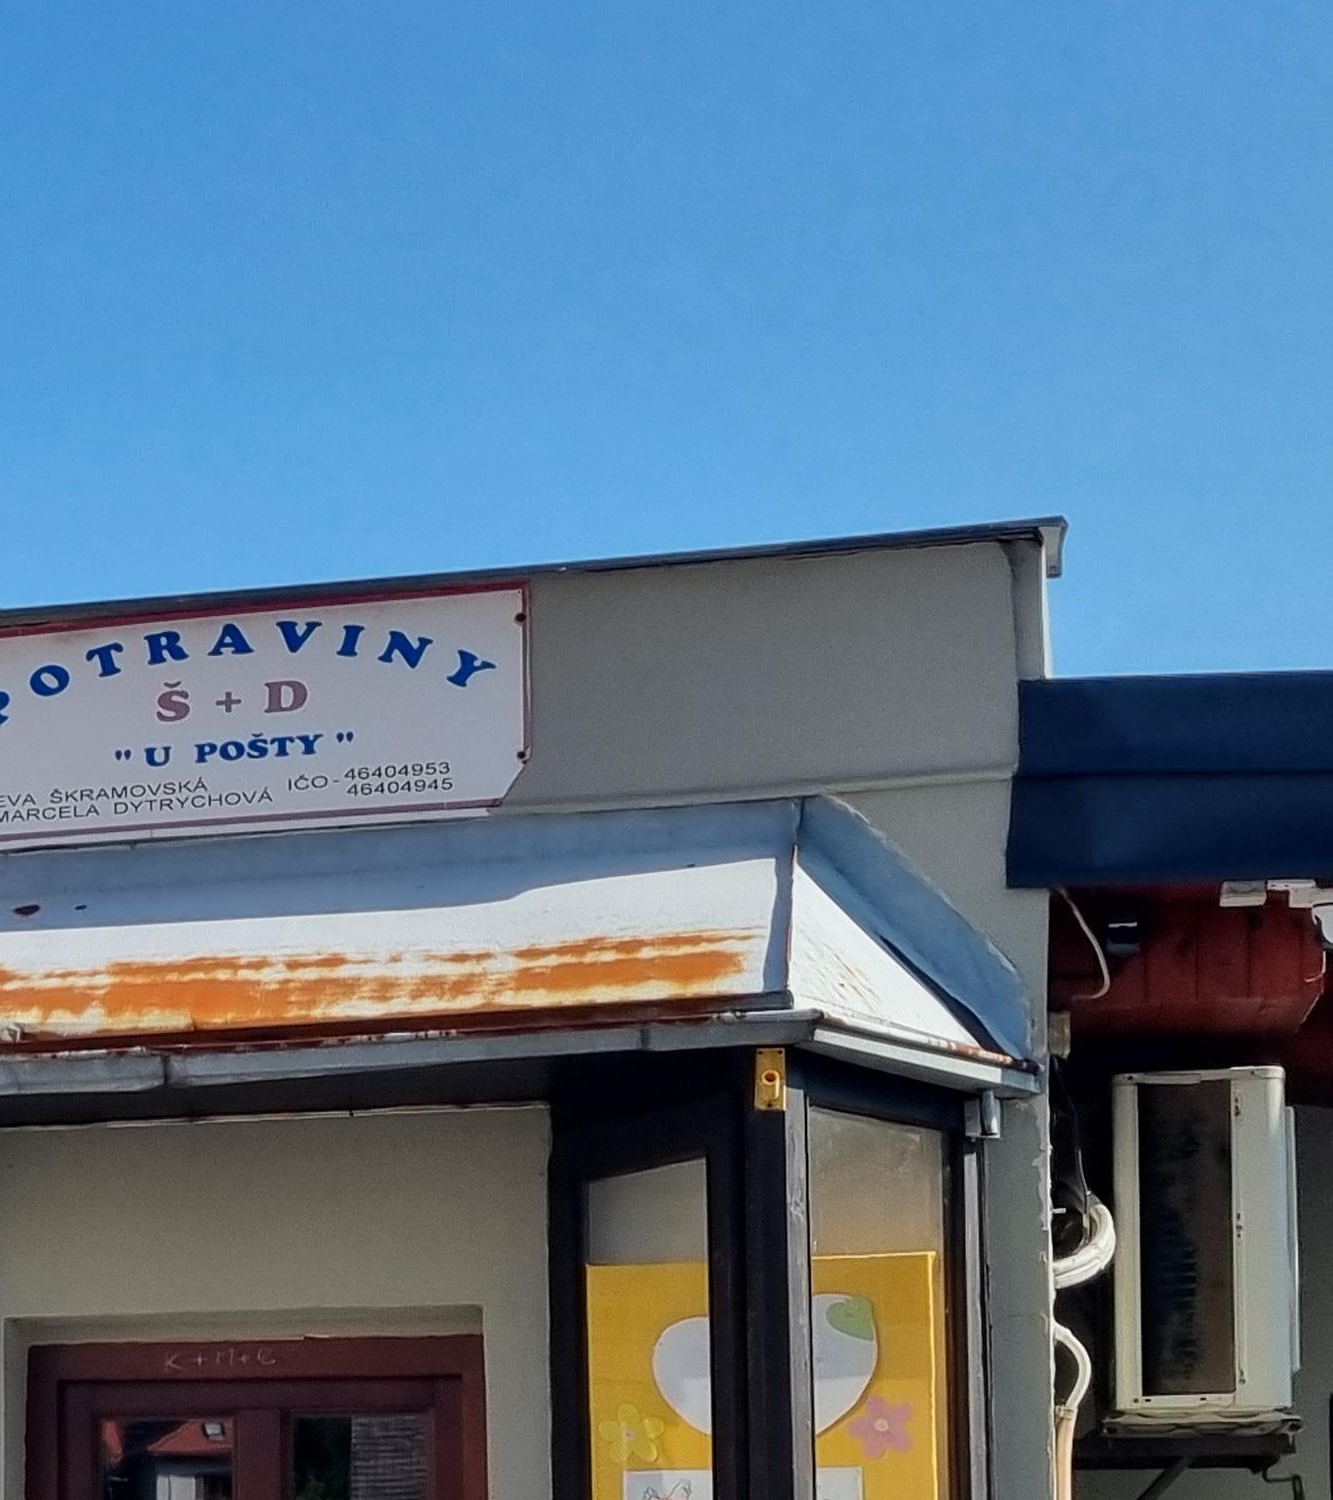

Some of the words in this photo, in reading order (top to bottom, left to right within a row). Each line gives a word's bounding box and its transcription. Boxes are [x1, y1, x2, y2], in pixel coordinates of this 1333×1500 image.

[156, 681, 190, 722] Š
[216, 691, 241, 713] +
[263, 680, 308, 713] D
[49, 777, 207, 805] ŠKRAMOVSKÁ
[344, 761, 451, 781] 46404953
[114, 787, 273, 816] DYTRYCHOVÁ
[346, 777, 453, 797] 46404945
